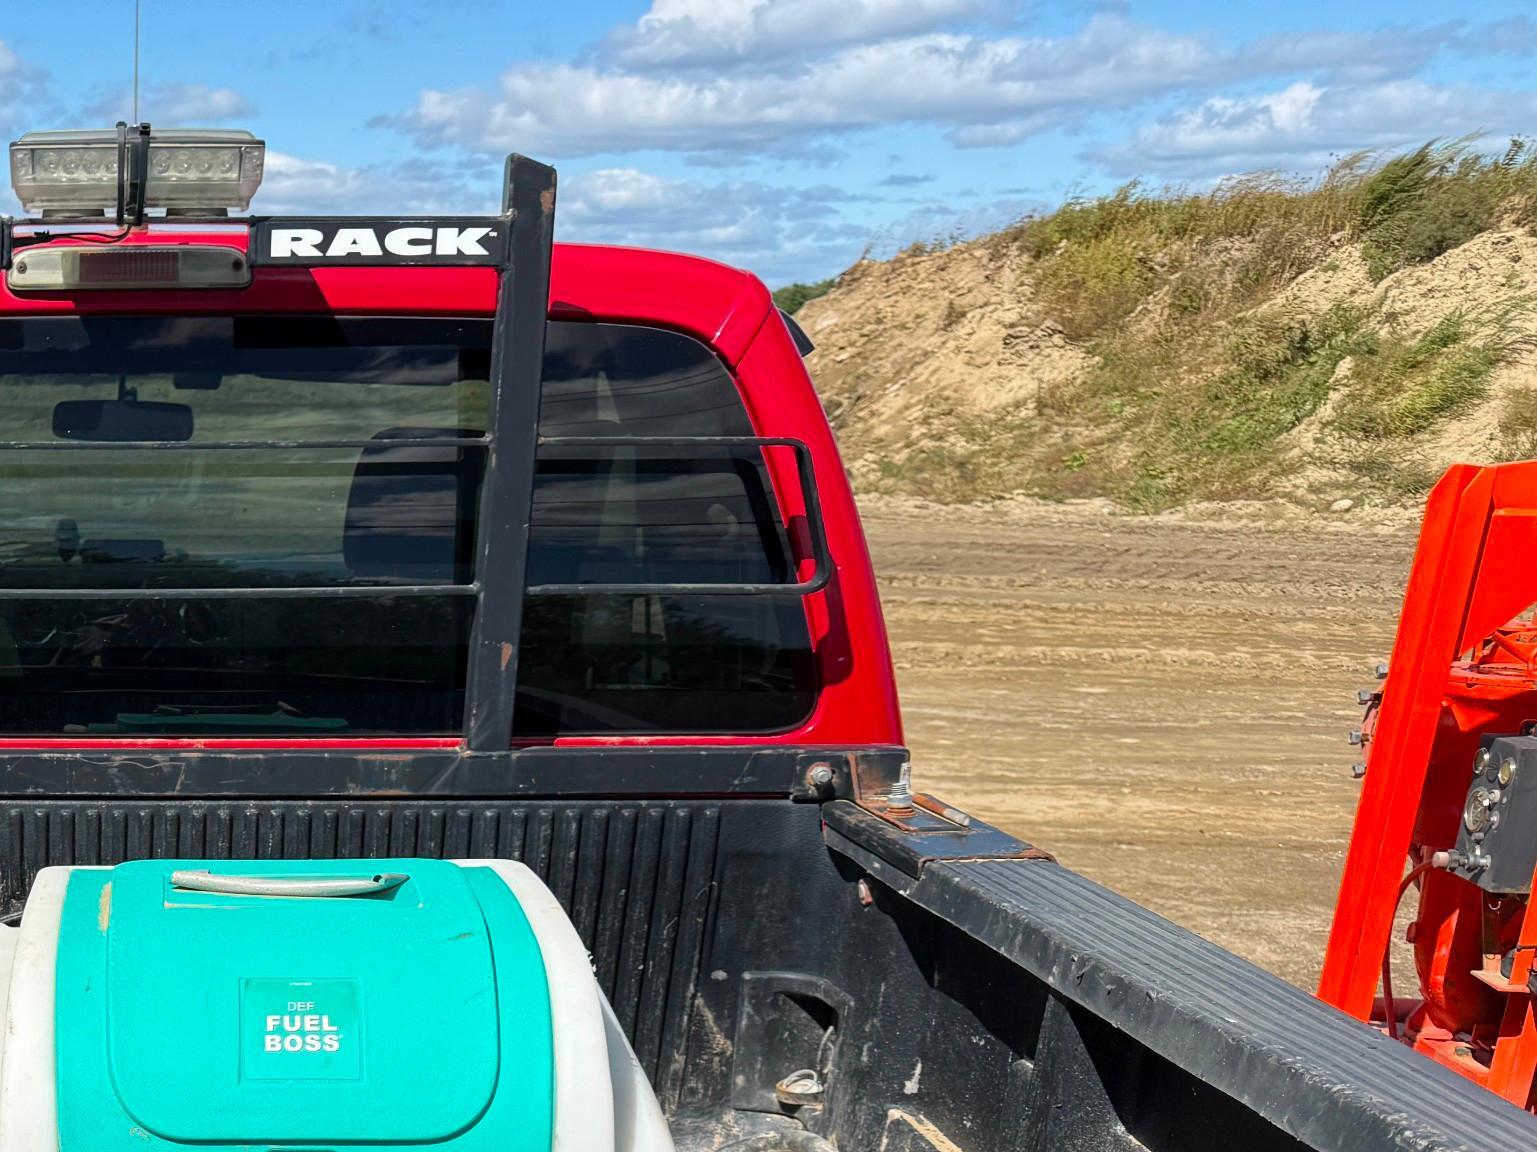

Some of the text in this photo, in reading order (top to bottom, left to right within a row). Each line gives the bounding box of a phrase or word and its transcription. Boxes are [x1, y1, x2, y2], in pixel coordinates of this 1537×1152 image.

[270, 227, 493, 258] RACK
[287, 1001, 315, 1012] DEF
[266, 1014, 338, 1032] FUEL
[264, 1034, 340, 1052] BOSS
